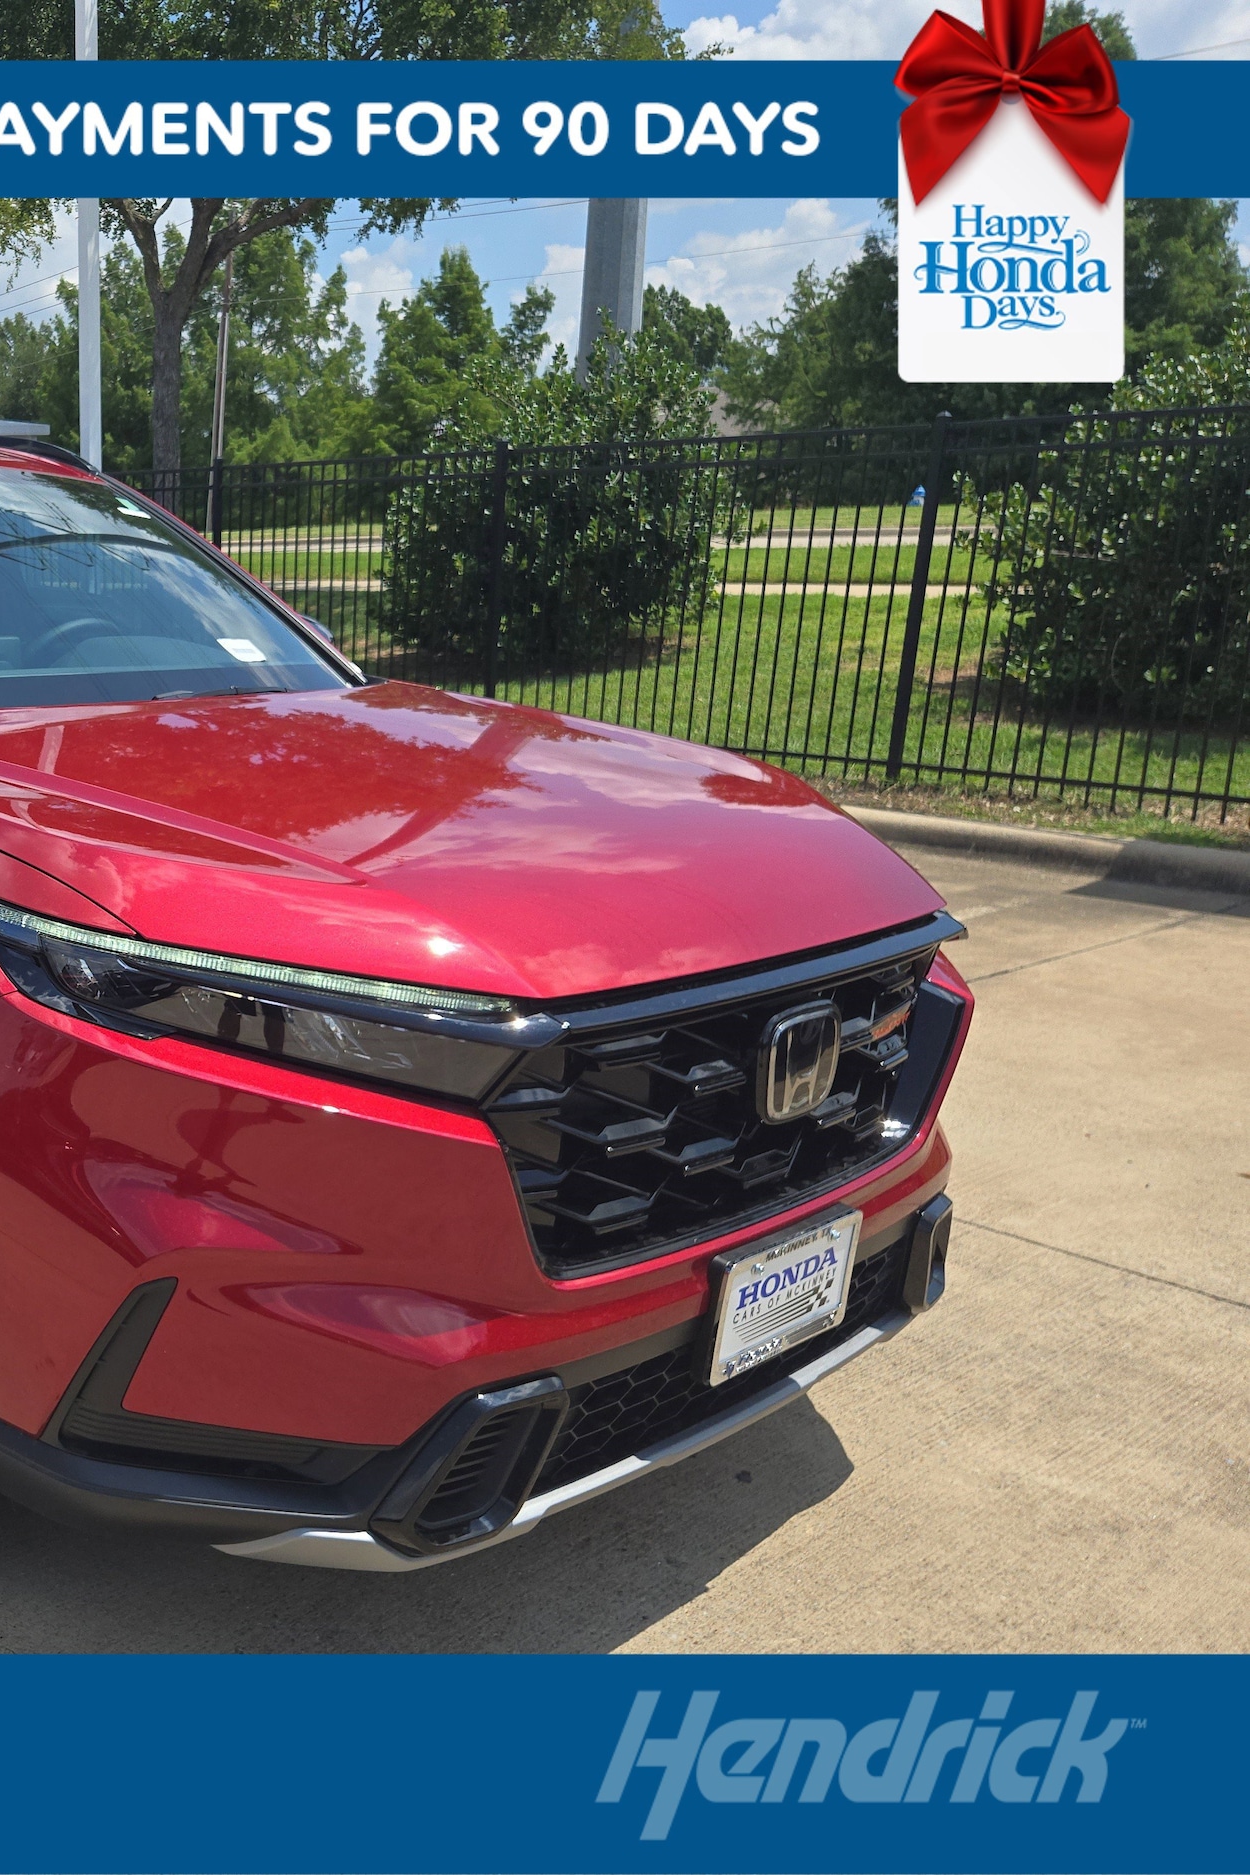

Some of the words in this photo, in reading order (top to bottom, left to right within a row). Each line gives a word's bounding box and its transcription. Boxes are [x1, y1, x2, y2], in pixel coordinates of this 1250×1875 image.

[733, 1303, 761, 1324] CARS
[768, 1293, 781, 1308] OF
[786, 1267, 836, 1300] MCKINNEY
[736, 1247, 837, 1310] HONDA
